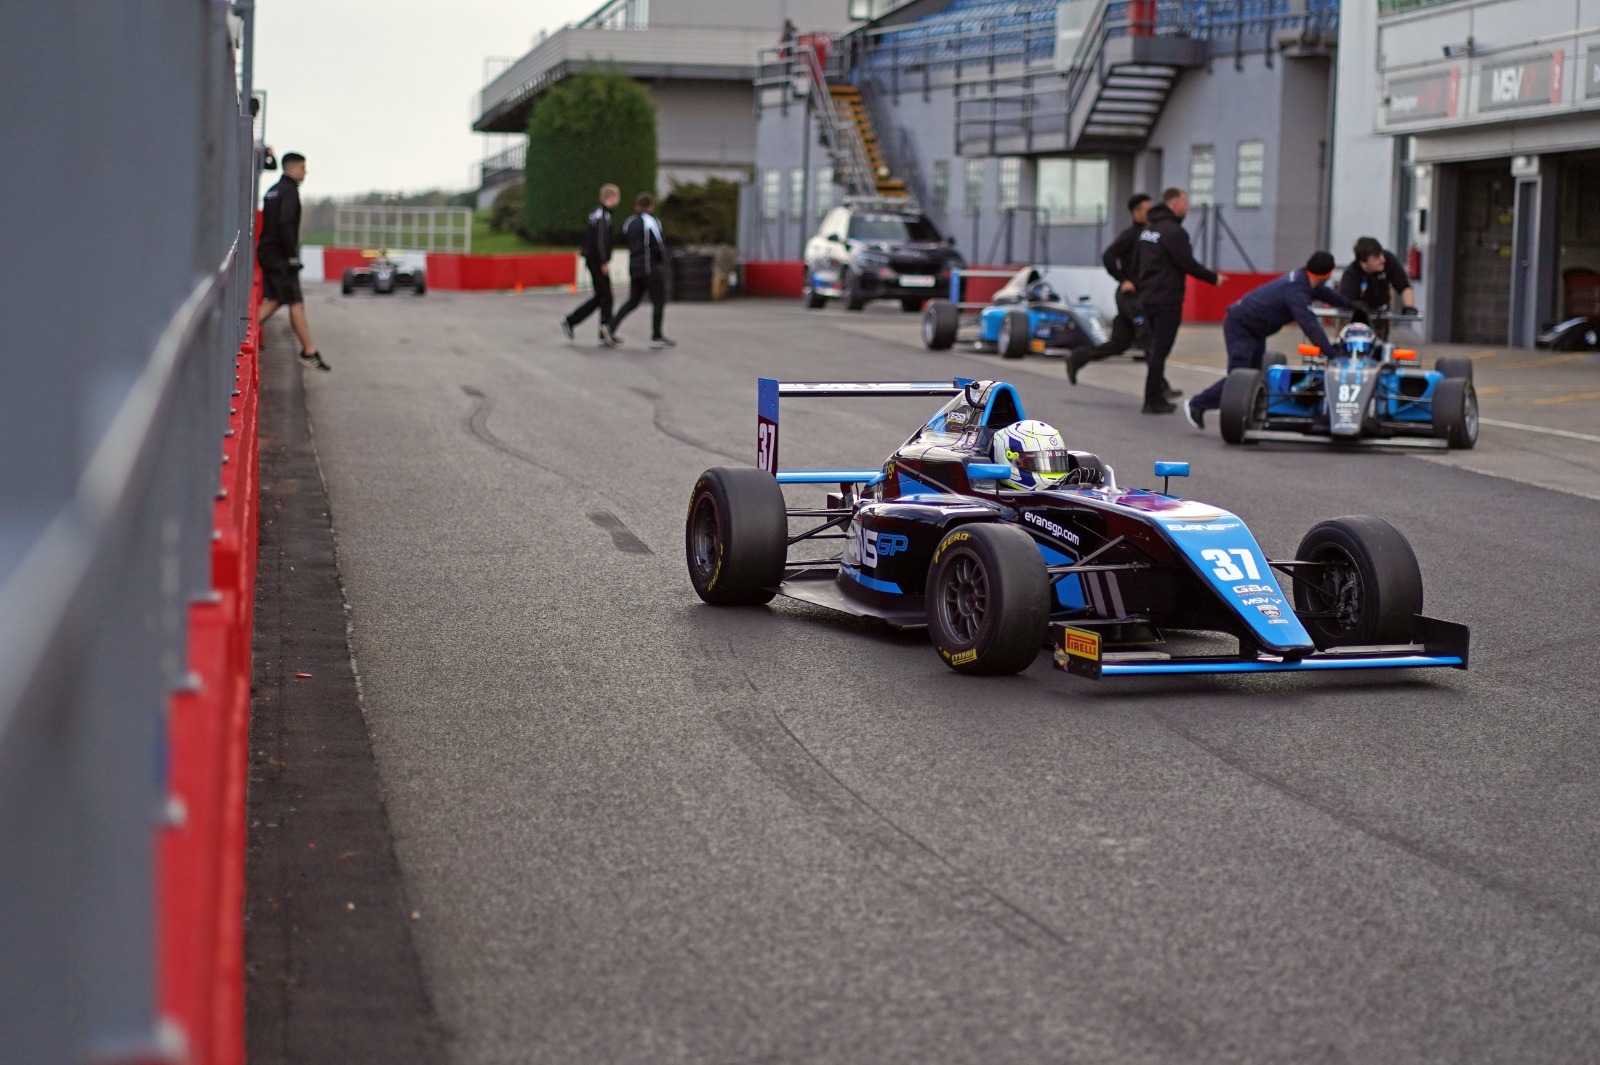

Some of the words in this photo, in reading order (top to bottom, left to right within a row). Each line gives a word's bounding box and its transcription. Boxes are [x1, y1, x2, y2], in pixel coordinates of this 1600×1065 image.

[1339, 384, 1361, 402] 87
[758, 423, 776, 475] 37
[1024, 511, 1080, 546] evansgp.com
[941, 533, 969, 552] ZERO
[1200, 548, 1261, 581] 37
[1232, 584, 1273, 594] GB4
[1066, 632, 1097, 656] PIRELLI
[951, 648, 978, 666] PIRELLI
